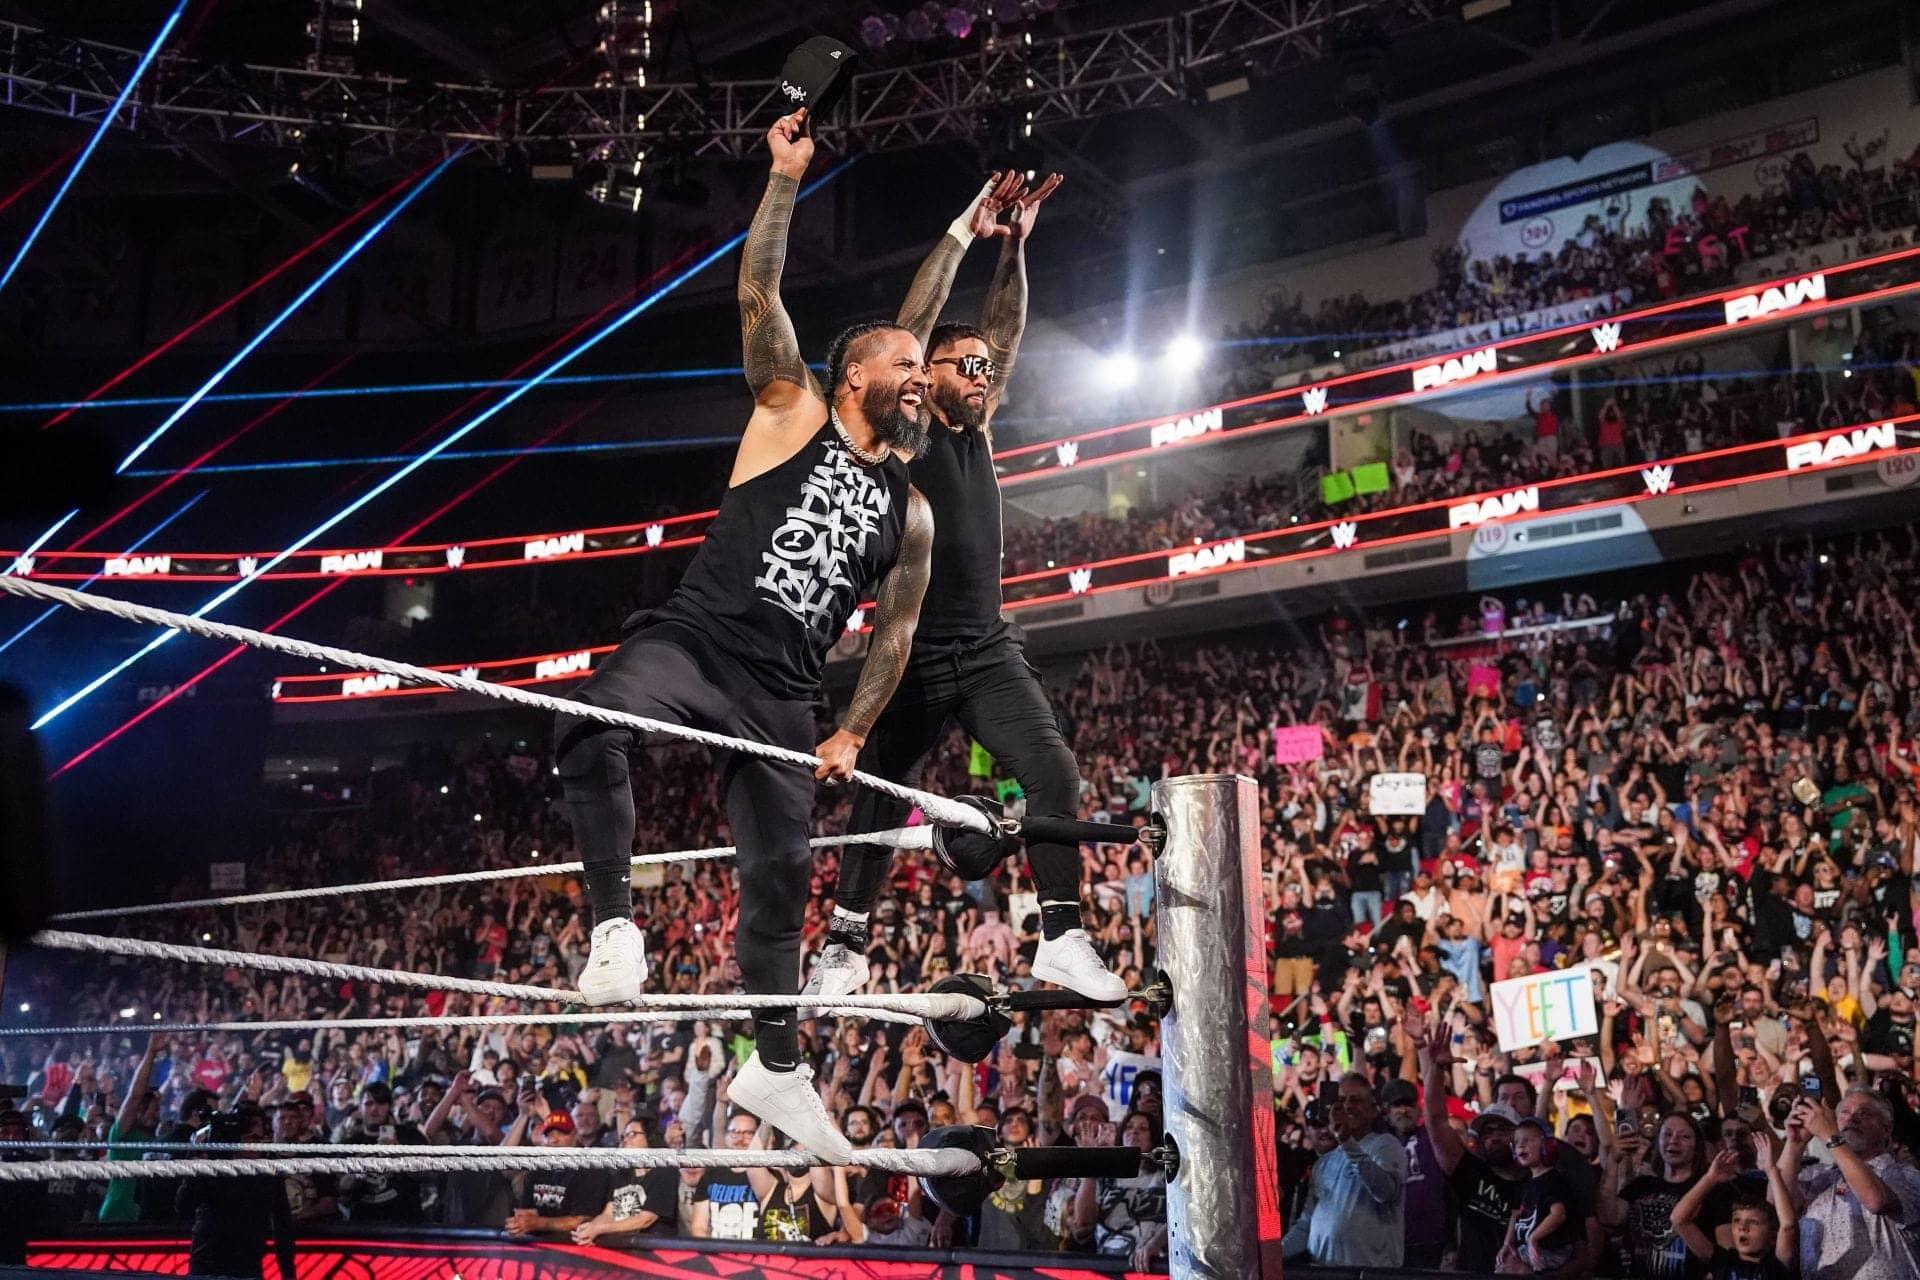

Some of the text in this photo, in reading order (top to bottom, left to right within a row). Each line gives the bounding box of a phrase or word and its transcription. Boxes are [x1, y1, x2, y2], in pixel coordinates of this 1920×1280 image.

[1151, 407, 1223, 448] RAW
[1413, 347, 1497, 391] RAW
[1725, 273, 1826, 325] RAW
[1886, 456, 1916, 475] 120
[1169, 539, 1246, 578] RAW
[1449, 486, 1540, 530] RAW
[1786, 422, 1897, 471] RAW
[104, 556, 171, 577] RAW
[321, 550, 383, 574] RAW
[525, 533, 585, 560] RAW
[536, 652, 591, 679] RAW
[1494, 975, 1586, 1043] YEET
